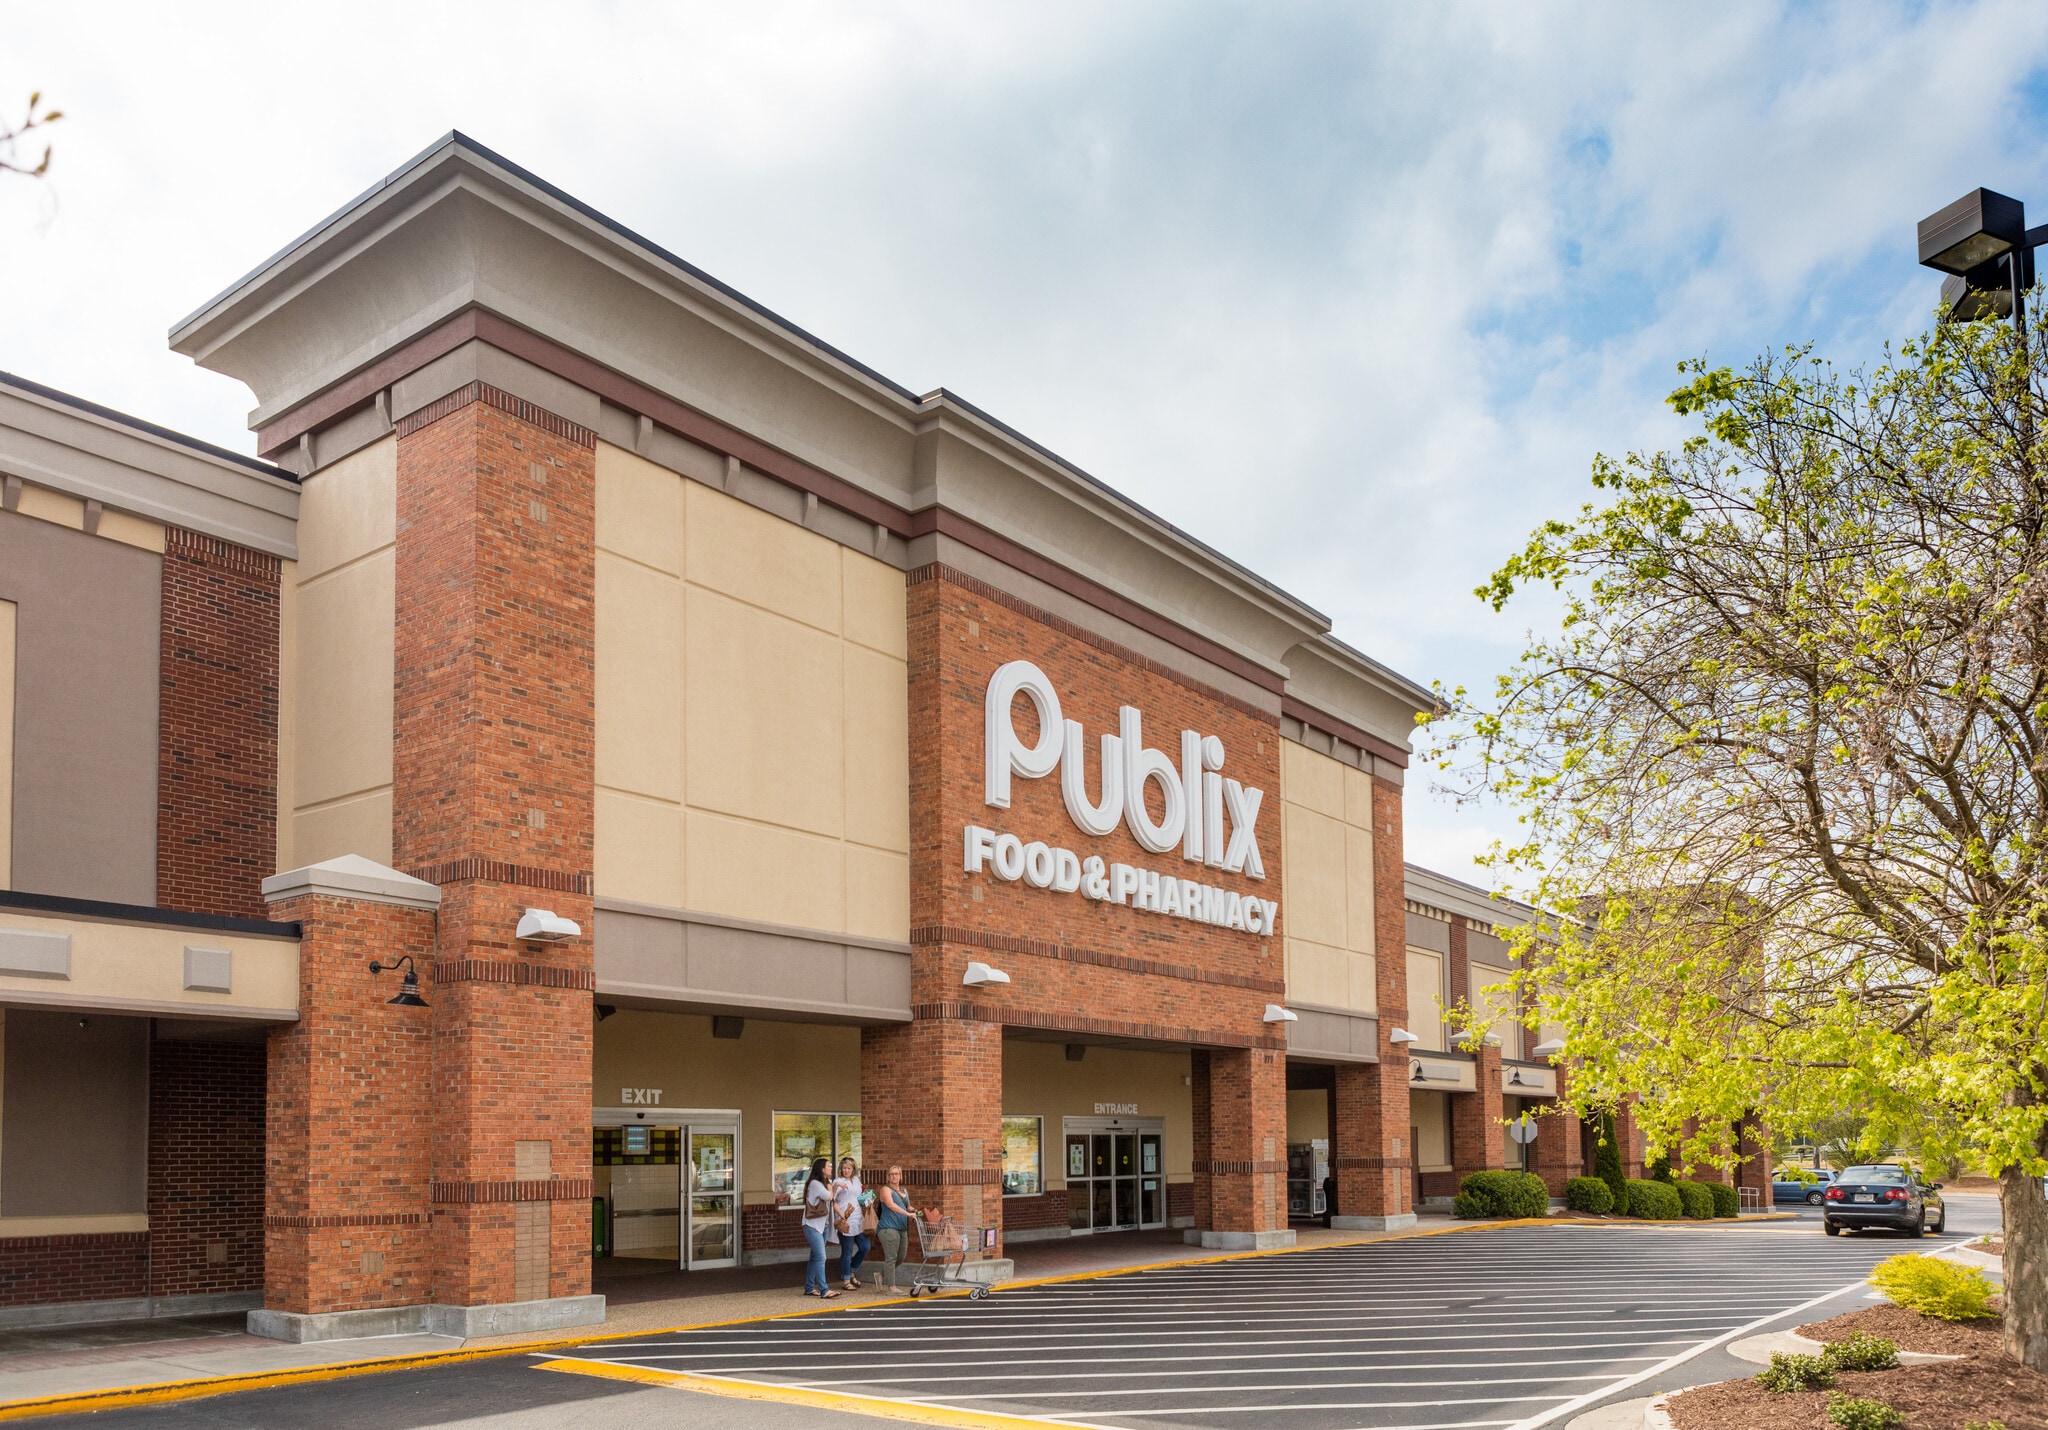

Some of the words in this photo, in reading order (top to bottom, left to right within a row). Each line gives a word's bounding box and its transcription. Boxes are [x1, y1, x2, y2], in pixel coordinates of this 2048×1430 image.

[985, 660, 1266, 879] Publix
[621, 1088, 663, 1105] EXIT
[1094, 1102, 1138, 1115] ENTRANCE
